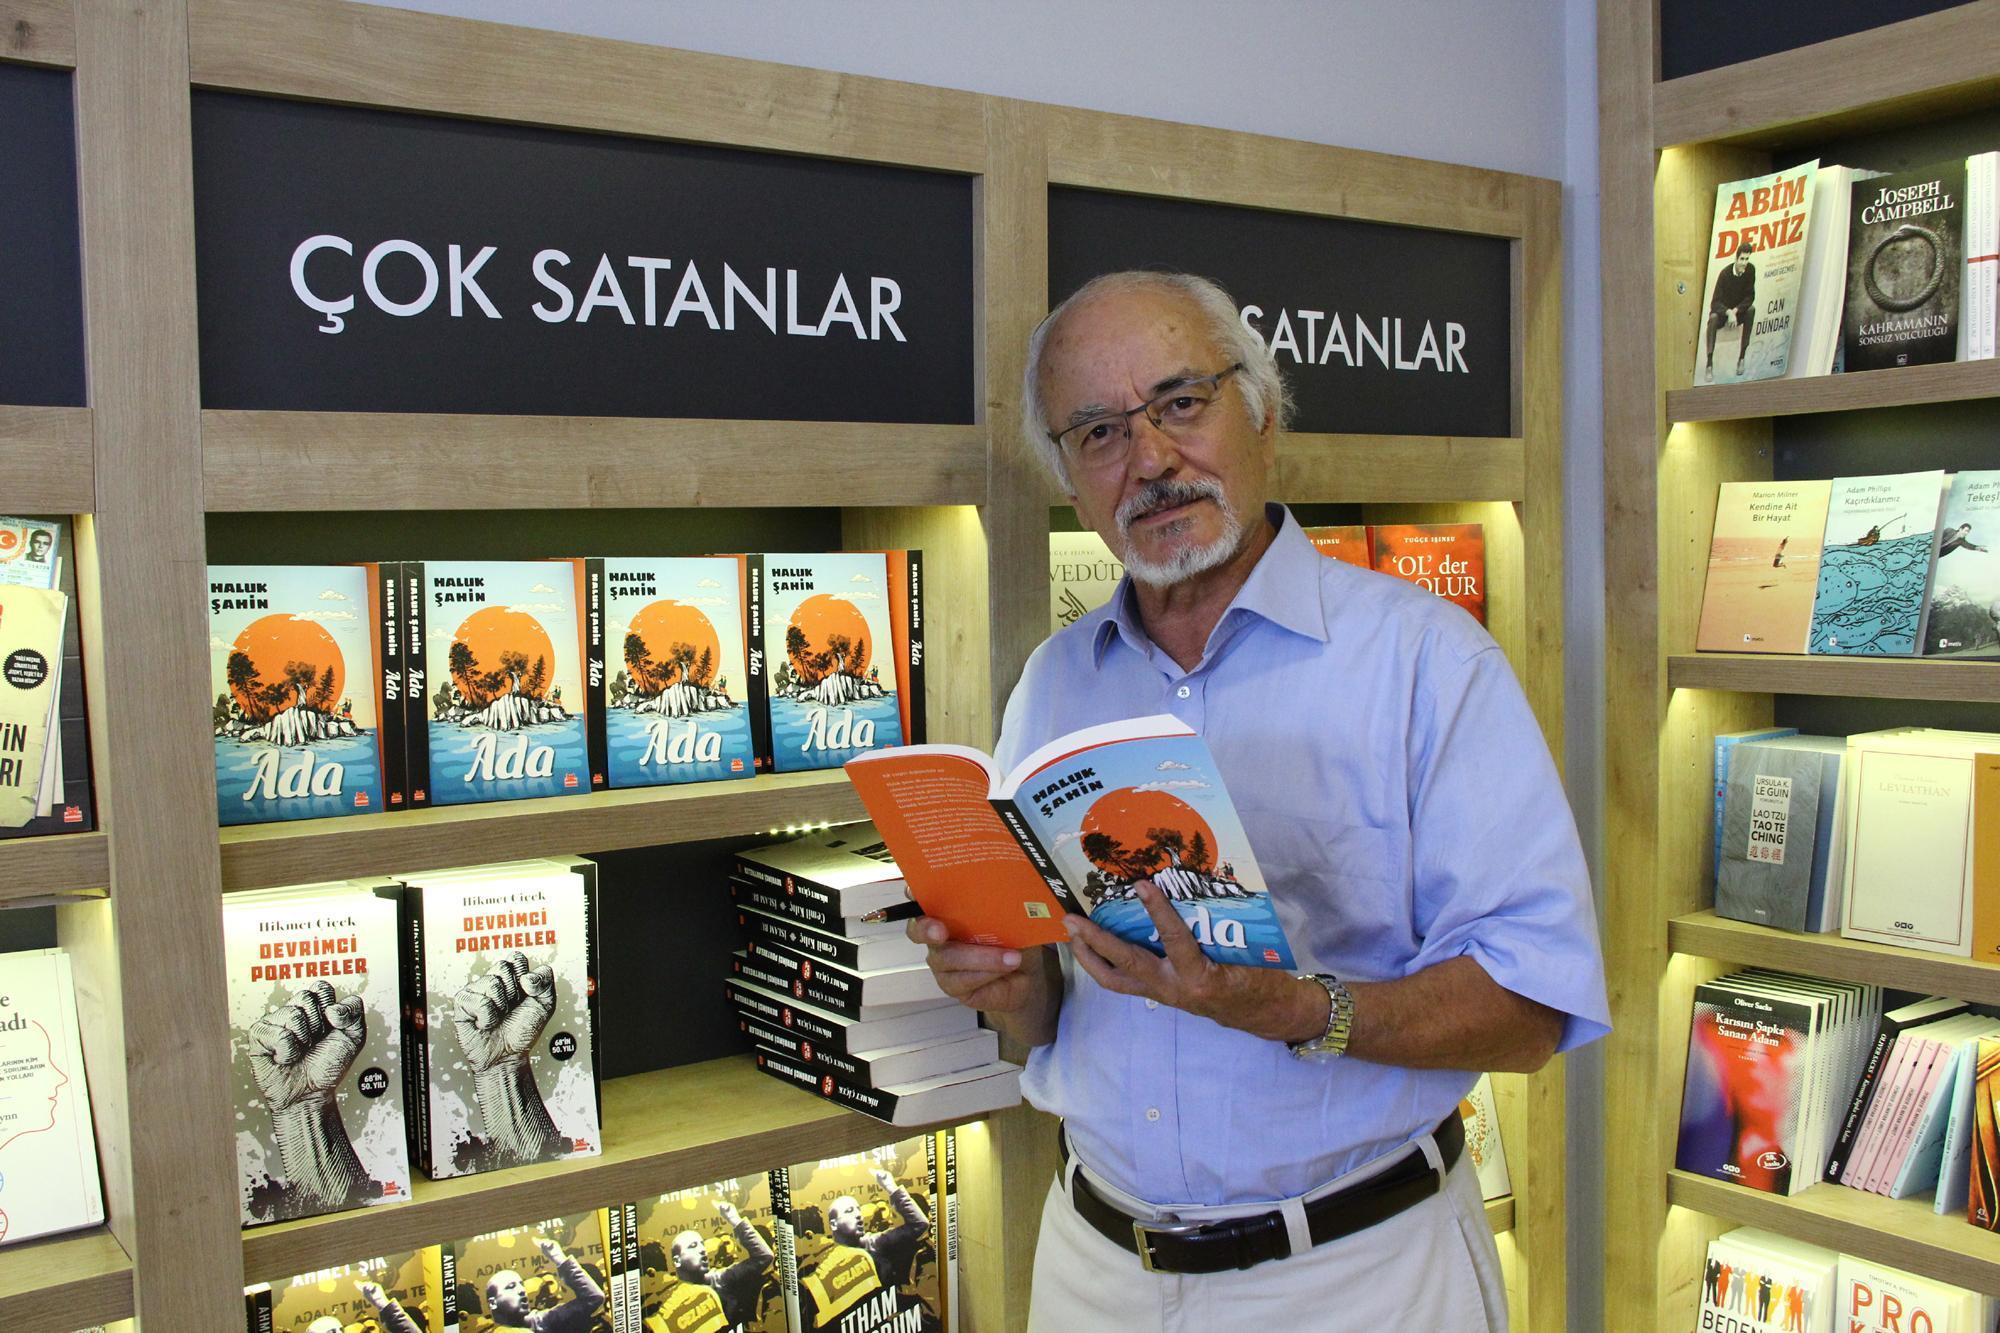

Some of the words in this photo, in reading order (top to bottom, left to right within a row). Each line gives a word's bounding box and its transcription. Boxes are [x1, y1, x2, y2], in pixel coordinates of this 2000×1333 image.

[1725, 174, 1808, 222] ABİM
[1874, 179, 1941, 208] JOSEPH
[1861, 194, 1955, 225] CAMPBELL
[1715, 209, 1807, 260] DENİZ
[290, 234, 502, 335] ÇOK
[531, 249, 907, 342] SATANLAR
[1767, 298, 1785, 315] CAN
[1756, 315, 1790, 336] DÜNDAR
[1859, 313, 1948, 336] KAHRAMANIN
[1239, 304, 1470, 374] SATANLAR
[1858, 333, 1893, 347] SONSUZ
[1894, 326, 1948, 342] YOLCULUĞU
[1752, 491, 1775, 499] Marion
[1846, 486, 1866, 494] Adam
[1867, 485, 1891, 494] Phillips
[1749, 502, 1783, 511] Kendine
[1784, 502, 1798, 510] Ait
[1752, 513, 1764, 522] Bir
[1766, 513, 1791, 523] Hayat
[771, 568, 813, 577] HALUK
[1049, 559, 1126, 582] VEDÛD
[1438, 553, 1469, 575] der
[211, 582, 268, 594] HALUK
[433, 577, 484, 587] HALUK
[609, 572, 656, 582] HALUK
[773, 578, 814, 594] ŞAHİN
[386, 579, 395, 612] HALUK
[409, 578, 418, 611] HALUK
[434, 588, 486, 607] ŞAHİN
[591, 573, 599, 605] HALUK
[610, 583, 657, 600] ŞAHİN
[211, 595, 269, 614] ŞAHİN
[911, 592, 919, 629] ŞAHİN
[589, 606, 600, 646] ŞAHİN
[750, 599, 760, 637] ŞAHİN
[384, 613, 396, 656] ŞAHİN
[408, 612, 419, 655] ŞAHİN
[750, 647, 763, 676] Ada
[911, 639, 922, 666] Ada
[408, 667, 424, 699] Ada
[589, 657, 603, 687] Ada
[385, 668, 401, 700] Ada
[801, 706, 875, 752] Ada
[639, 718, 722, 767] Ada
[464, 732, 555, 782] Ada
[243, 748, 344, 801] Ada
[1032, 767, 1097, 804] HALUK
[1756, 777, 1782, 787] URSULA
[1040, 780, 1104, 819] ŞAHİN
[1755, 786, 1765, 796] LE
[1766, 787, 1789, 798] GUIN
[1752, 820, 1773, 831] TAO
[1774, 822, 1785, 833] TE
[1753, 809, 1770, 819] LAO
[1770, 811, 1786, 821] TZU
[1751, 830, 1784, 845] CHING
[1004, 811, 1029, 841] HALUK
[1022, 840, 1047, 868] ŞAHİN
[1043, 875, 1068, 899] Ada
[463, 906, 547, 932] DEVRİMCİ
[455, 930, 556, 953] PORTRELER
[770, 924, 786, 940] İSLAM
[799, 932, 815, 950] Kılıç
[259, 933, 357, 959] DEVRİMCİ
[816, 941, 837, 957] Cemil
[251, 957, 368, 983] PORTRELER
[1734, 997, 1754, 1008] Oliver
[1755, 1001, 1773, 1012] Sacks
[1715, 1012, 1754, 1030] Karısını
[1756, 1020, 1785, 1036] Şapka
[1718, 1025, 1747, 1041] Sanan
[1748, 1031, 1779, 1047] Adam
[1874, 1033, 1887, 1055] OLIVER
[1867, 1055, 1879, 1073] SACKS
[361, 1082, 373, 1091] 50.
[373, 1080, 386, 1089] YILI
[927, 1135, 935, 1166] AHMET
[946, 1135, 955, 1166] AHMET
[781, 1167, 790, 1195] HMET
[946, 1168, 955, 1185] ŞIK
[610, 1209, 621, 1244] AHMET
[626, 1205, 637, 1240] AHMET
[610, 1246, 622, 1266] ŞIK
[625, 1241, 637, 1261] ŞIK
[443, 1254, 456, 1291] AHMET
[443, 1293, 456, 1314] ŞIK
